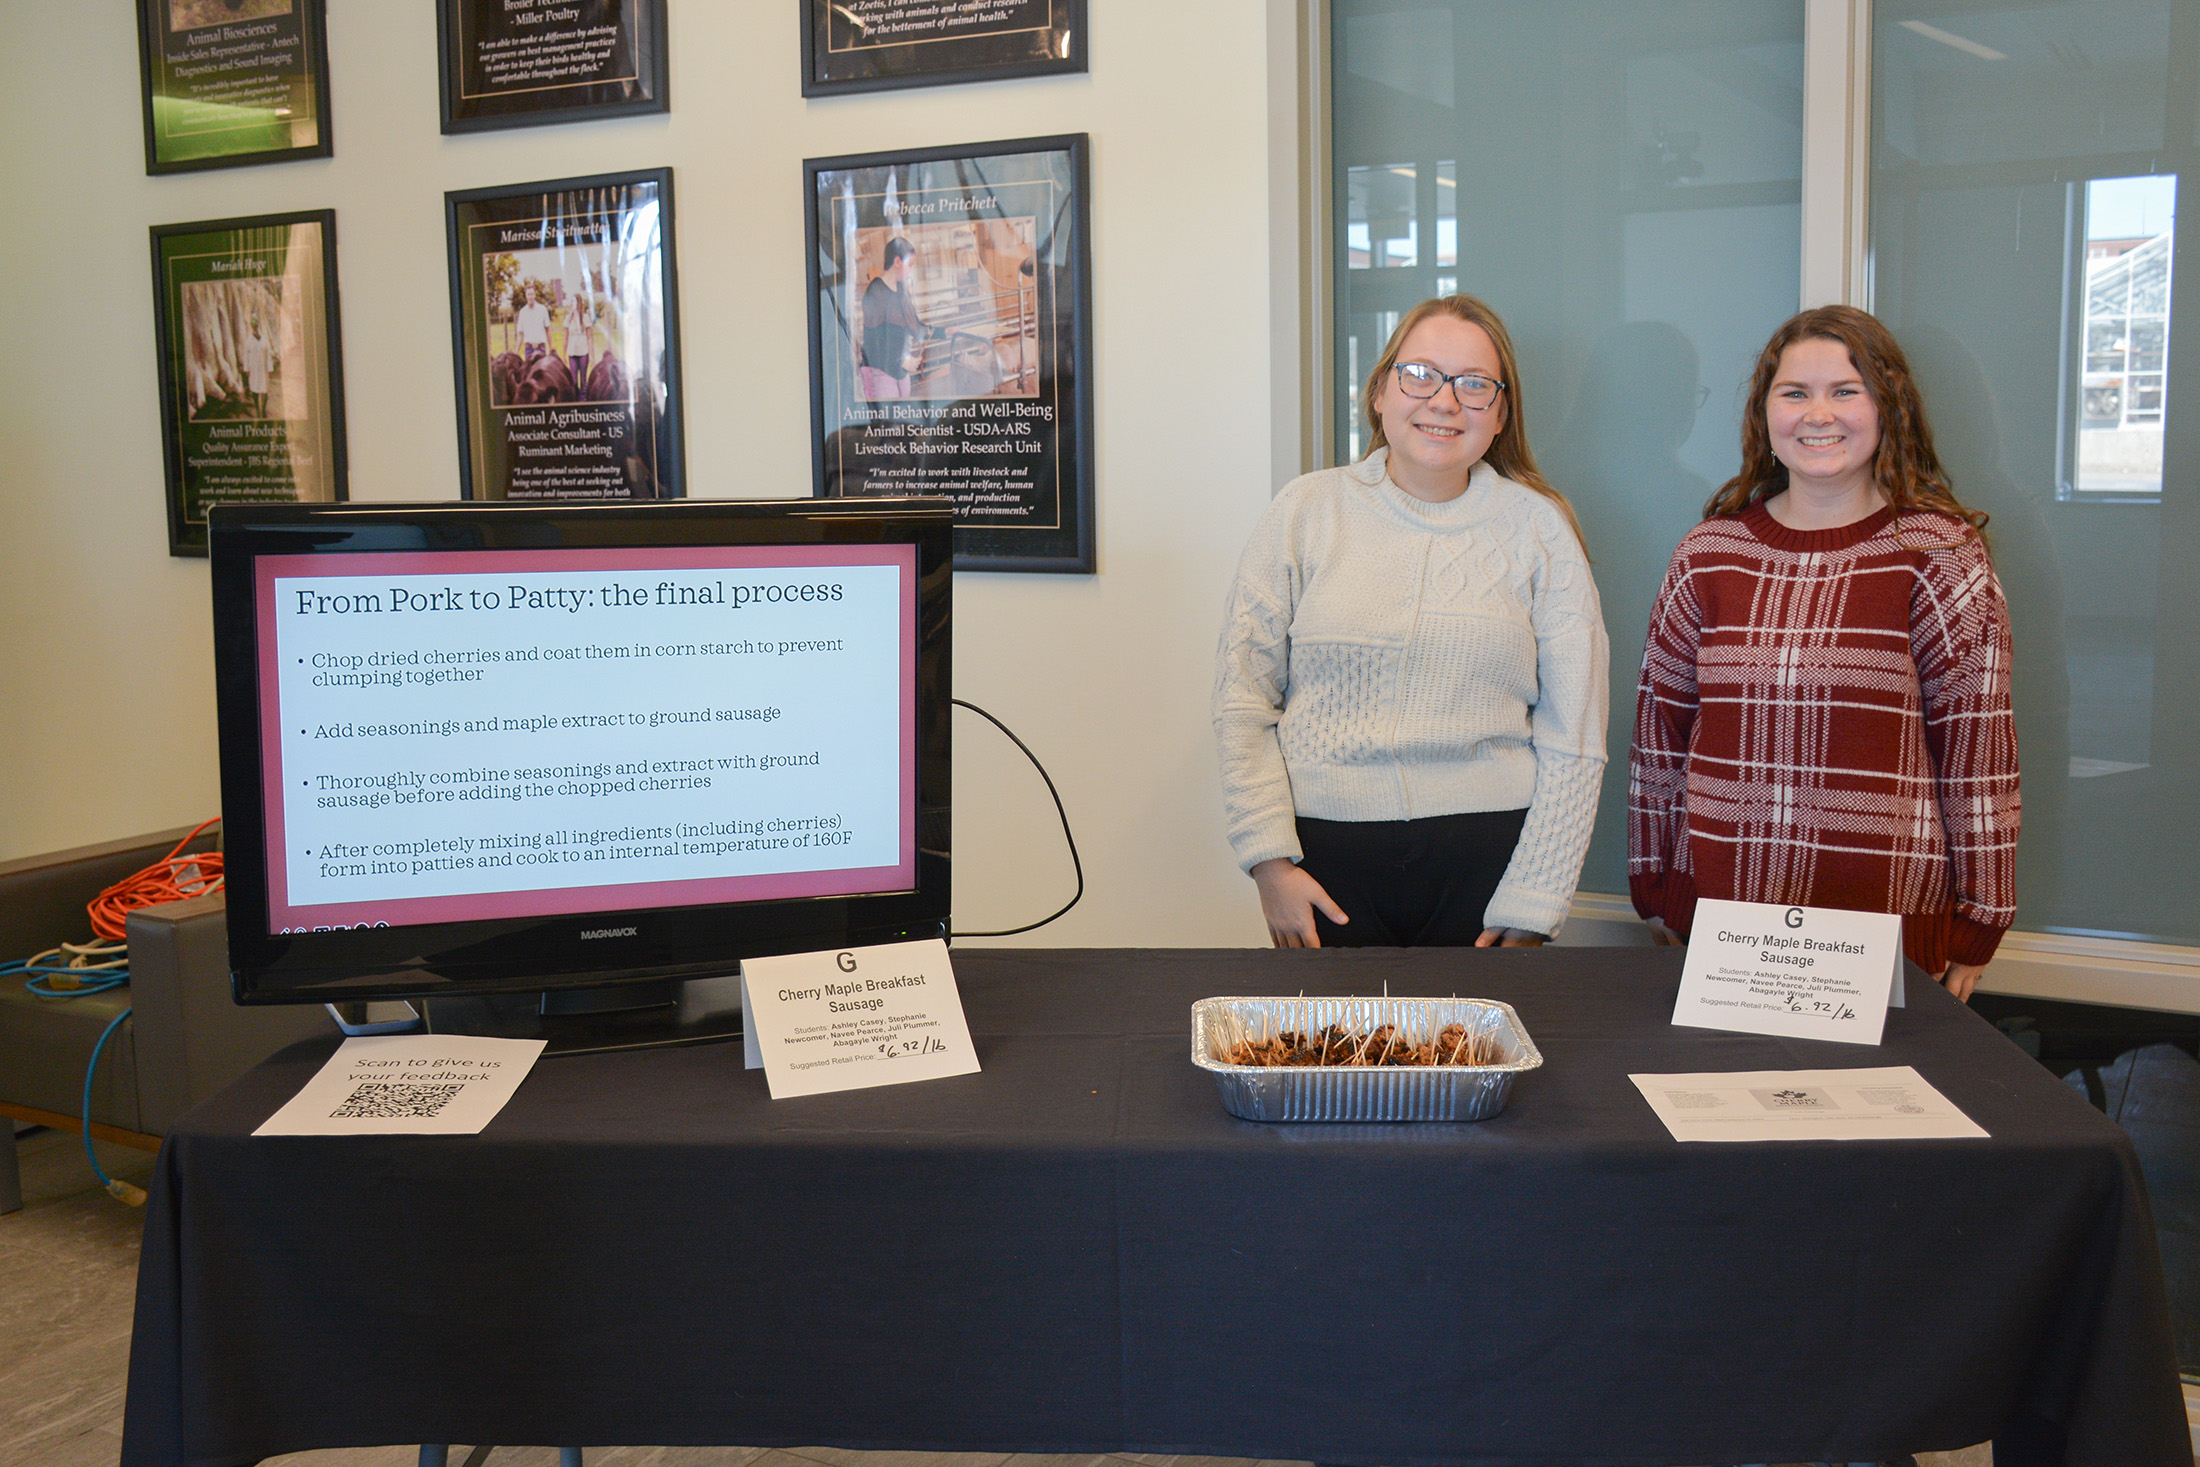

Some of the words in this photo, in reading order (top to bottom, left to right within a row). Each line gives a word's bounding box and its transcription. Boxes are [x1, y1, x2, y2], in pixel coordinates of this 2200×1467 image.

[515, 12, 543, 26] Miller
[545, 7, 580, 22] Poultry
[863, 26, 876, 39] for
[877, 24, 891, 34] the
[892, 19, 936, 32] betterment
[937, 17, 947, 30] of
[948, 13, 978, 26] animal
[186, 29, 221, 46] Animal
[223, 23, 278, 40] Biosciences
[166, 50, 190, 64] Inside
[190, 48, 210, 60] Sales
[210, 41, 265, 59] Representative
[271, 34, 300, 49] Antech
[175, 63, 218, 78] Diagnostics
[218, 59, 233, 71] and
[260, 52, 293, 67] Imaging
[939, 195, 997, 213] Pritchett
[500, 228, 542, 243] Marissa
[504, 410, 546, 426] Animal
[549, 408, 625, 429] Agribusiness
[843, 406, 889, 421] Animal
[893, 405, 949, 419] Behavior
[952, 404, 976, 418] and
[980, 402, 1053, 422] Well-Being
[209, 425, 243, 439] Animal
[245, 424, 286, 438] Products
[508, 430, 549, 442] Associate
[550, 428, 600, 441] Consultant
[608, 426, 624, 439] US
[864, 424, 905, 438] Animal
[907, 423, 954, 437] Scientist
[964, 422, 1031, 436] USDA-ARS
[519, 445, 563, 458] Ruminant
[564, 443, 613, 459] Marketing
[855, 442, 907, 456] Livestock
[909, 441, 959, 455] Behavior
[962, 440, 1013, 454] Research
[1015, 440, 1042, 453] Unit
[296, 590, 383, 615] From
[389, 587, 464, 612] Pork
[470, 589, 501, 610] to
[507, 585, 594, 614] Patty:
[600, 583, 649, 607] the
[655, 581, 726, 605] final
[731, 582, 844, 609] process
[311, 652, 363, 670] Chop
[367, 650, 420, 666] dried
[423, 648, 501, 664] cherries
[504, 646, 540, 662] and
[543, 646, 582, 660] coat
[585, 644, 631, 659] them
[634, 643, 651, 658] in
[655, 644, 697, 657] corn
[699, 640, 755, 655] starch
[757, 641, 775, 654] to
[777, 638, 844, 656] prevent
[312, 669, 402, 688] clumping
[405, 667, 485, 686] together
[314, 723, 354, 739] Add
[357, 719, 461, 738] seasonings
[463, 717, 499, 732] and
[502, 715, 558, 733] maple
[561, 712, 626, 728] extract
[628, 712, 646, 725] to
[649, 707, 712, 728] ground
[715, 706, 782, 723] sausage
[316, 771, 426, 791] Thoroughly
[429, 767, 510, 785] combine
[513, 762, 611, 779] seasonings
[615, 760, 649, 775] and
[652, 758, 715, 773] extract
[717, 755, 756, 770] with
[759, 751, 820, 771] ground
[316, 792, 391, 809] sausage
[393, 788, 455, 805] before
[458, 784, 522, 802] adding
[525, 782, 554, 797] the
[557, 777, 636, 797] chopped
[639, 775, 712, 791] cherries
[319, 844, 369, 860] After
[372, 836, 475, 857] completely
[479, 833, 542, 852] mixing
[545, 830, 568, 845] all
[571, 825, 672, 846] ingredients
[675, 819, 765, 840] (including
[767, 813, 843, 833] cherries)
[319, 862, 367, 878] form
[371, 860, 408, 875] into
[411, 855, 475, 875] patties
[478, 852, 512, 868] and
[515, 848, 561, 865] cook
[563, 849, 580, 863] to
[583, 848, 606, 862] an
[609, 842, 679, 860] internal
[683, 836, 790, 857] temperature
[792, 833, 811, 848] of
[813, 830, 853, 847] 160F
[1784, 907, 1805, 929] G
[580, 927, 637, 940] MAGNAVOX
[1717, 930, 1759, 947] Cherry
[1762, 935, 1800, 952] Maple
[1803, 938, 1865, 955] Breakfast
[836, 951, 858, 973] G
[1760, 951, 1815, 968] Sausage
[1705, 974, 1748, 985] Newcomer,
[1750, 978, 1775, 987] Navee
[1776, 980, 1805, 991] Pearce,
[1807, 983, 1822, 992] Juli
[1822, 985, 1862, 996] Plummer,
[1718, 966, 1753, 977] Students:
[1753, 970, 1782, 982] Ashley
[1783, 973, 1809, 984] Casey,
[1811, 976, 1851, 987] Stephanie
[778, 986, 821, 1002] Cherry
[825, 982, 863, 998] Maple
[865, 974, 926, 992] Breakfast
[1749, 986, 1785, 998] Abagayle
[1787, 990, 1814, 1000] Wright
[829, 997, 884, 1013] Sausage
[1699, 997, 1739, 1008] Suggested
[1740, 1001, 1761, 1010] Retail
[1763, 1003, 1785, 1012] Price:
[784, 1034, 829, 1045] Newcomer,
[830, 1030, 856, 1040] Navee
[856, 1027, 886, 1037] Pearce,
[888, 1023, 903, 1033] Juli
[903, 1020, 941, 1031] Plummer,
[794, 1024, 830, 1035] Students:
[831, 1020, 858, 1031] Ashley
[860, 1018, 887, 1029] Casey,
[888, 1012, 927, 1025] Stephanie
[833, 1037, 870, 1049] Abagayle
[871, 1033, 898, 1045] Wright
[355, 1058, 400, 1068] Scan
[407, 1058, 428, 1068] to
[431, 1057, 473, 1069] give
[479, 1060, 502, 1069] us
[790, 1058, 830, 1071] Suggested
[832, 1055, 853, 1065] Retail
[855, 1053, 877, 1063] Price:
[348, 1072, 394, 1082] your
[399, 1071, 492, 1082] feedback
